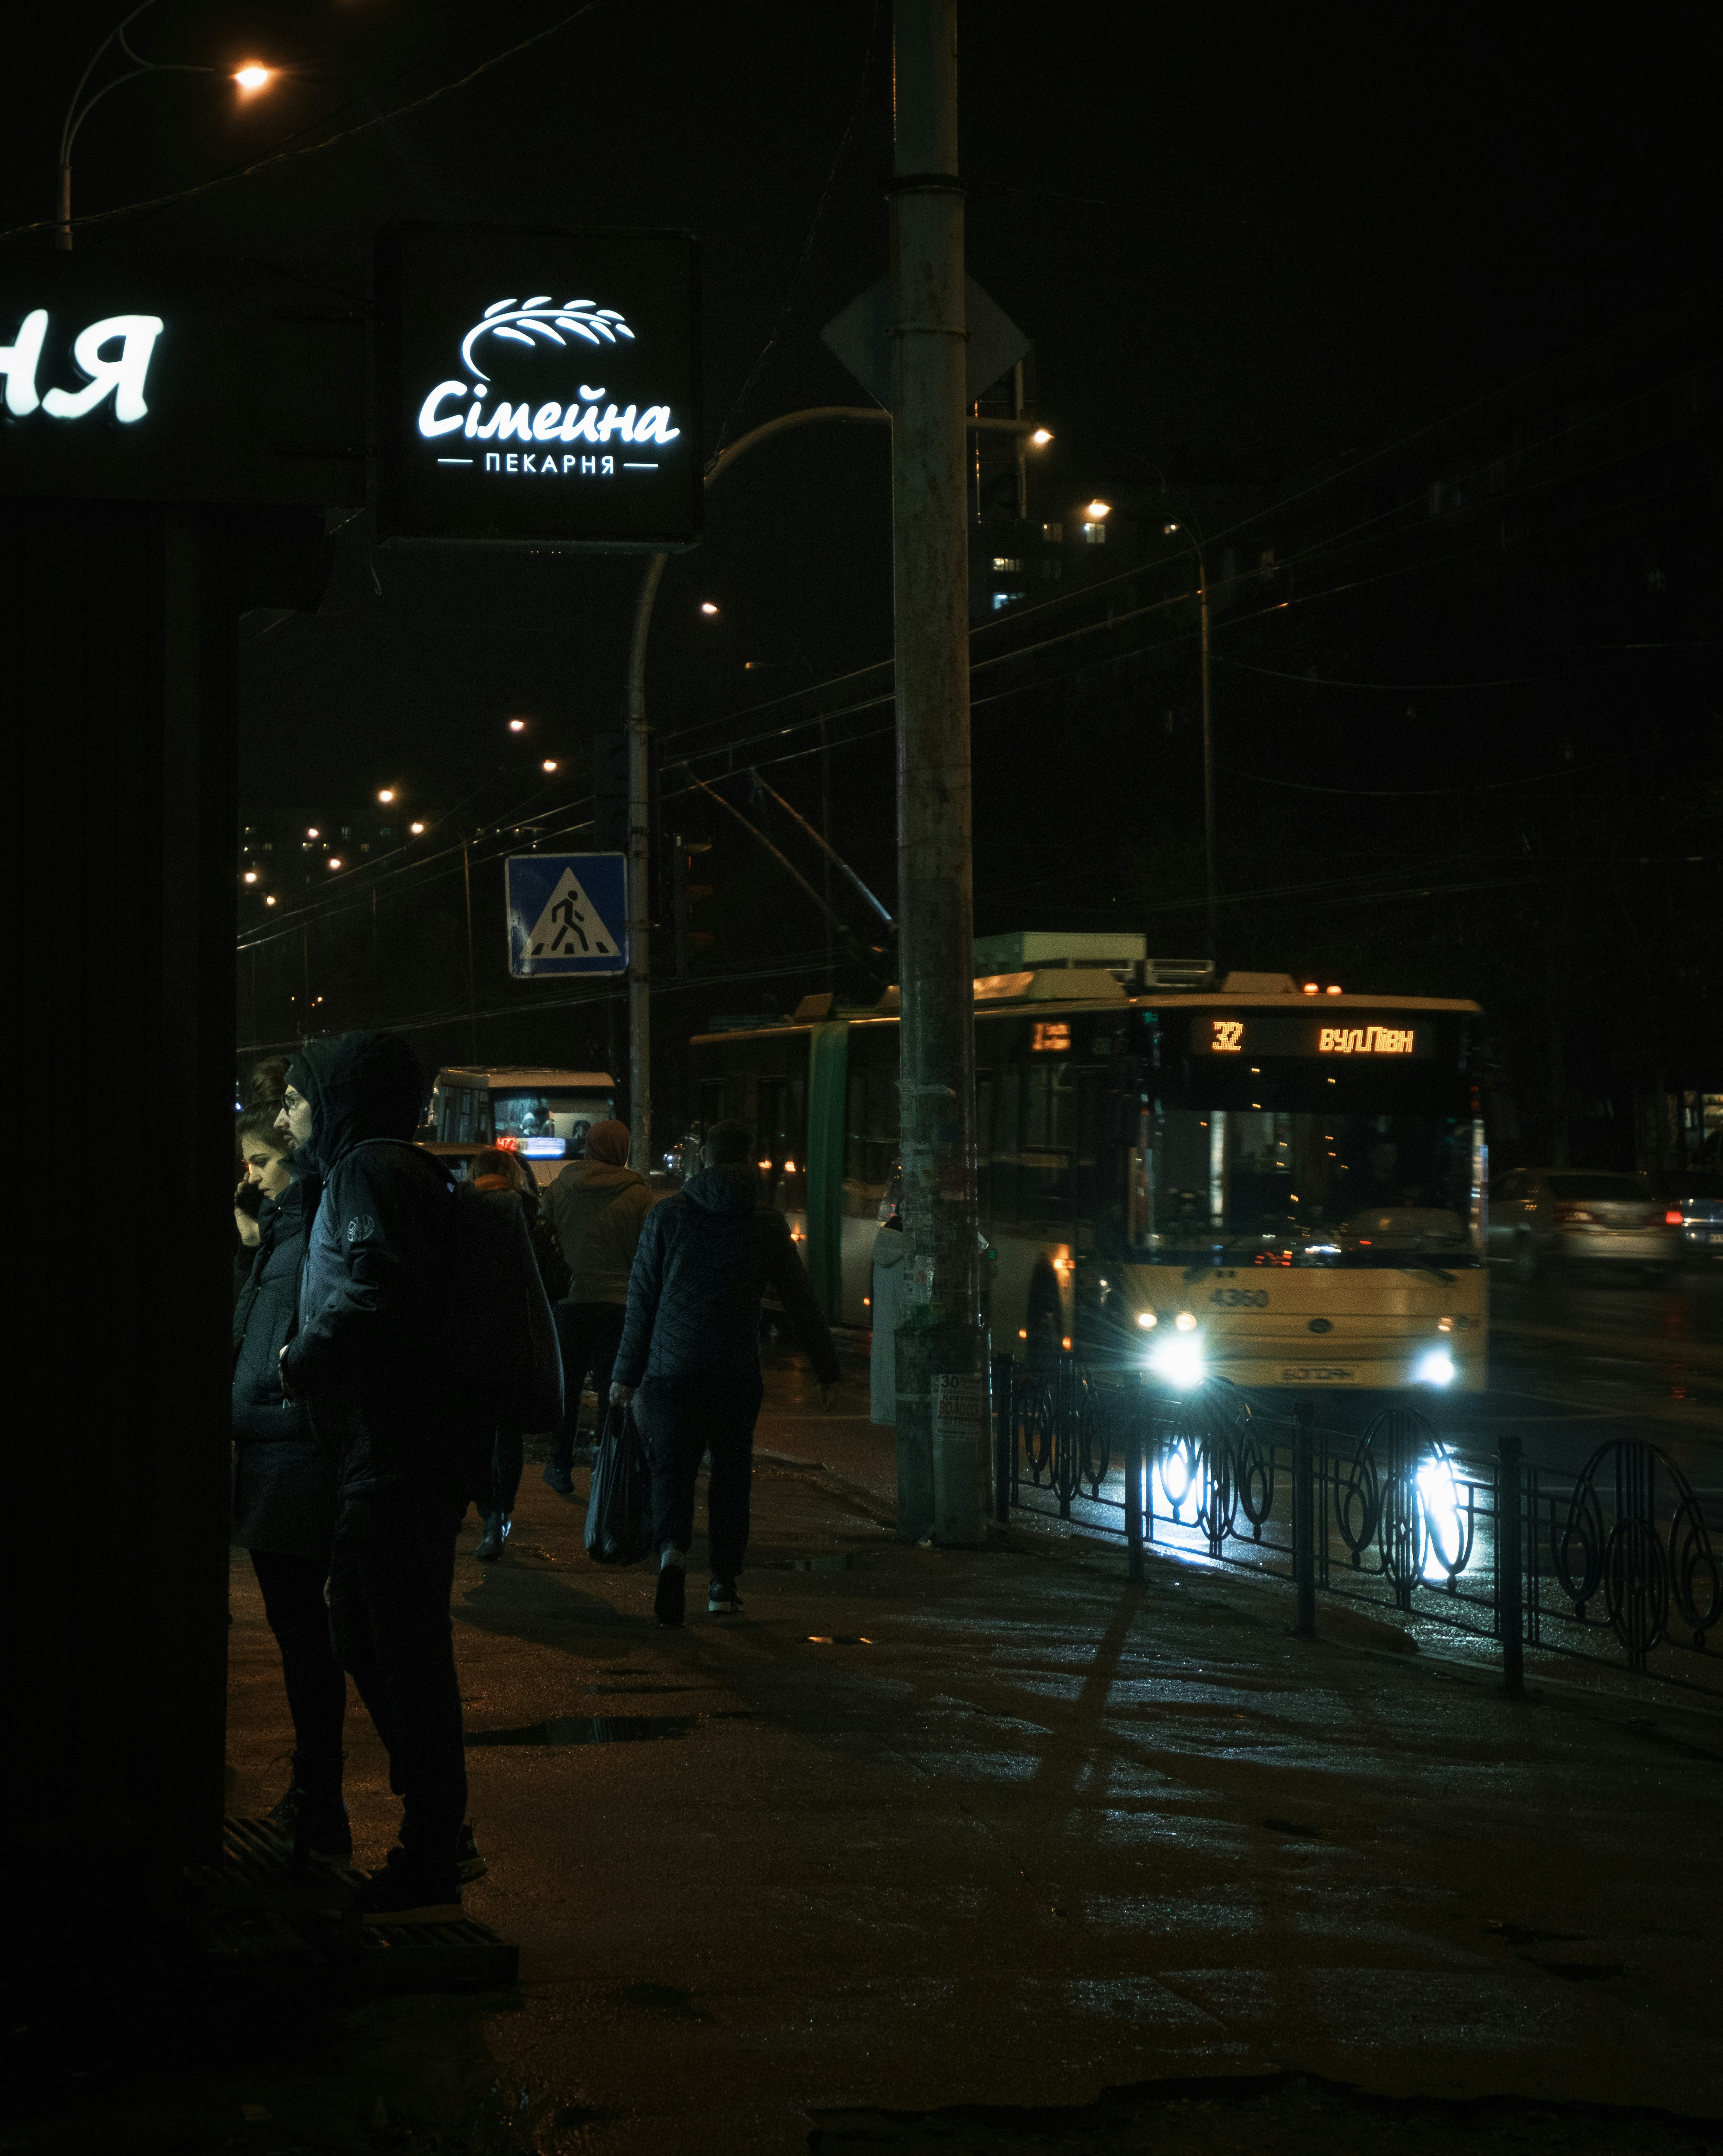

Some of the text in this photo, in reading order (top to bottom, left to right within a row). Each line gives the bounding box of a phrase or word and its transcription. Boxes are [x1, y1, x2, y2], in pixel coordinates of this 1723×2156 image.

[418, 380, 681, 444] Сімейна
[485, 453, 615, 474] ПЕКАРНЯ
[1212, 1021, 1243, 1051] 32
[1209, 1289, 1269, 1308] 4360
[941, 1375, 959, 1388] 30
